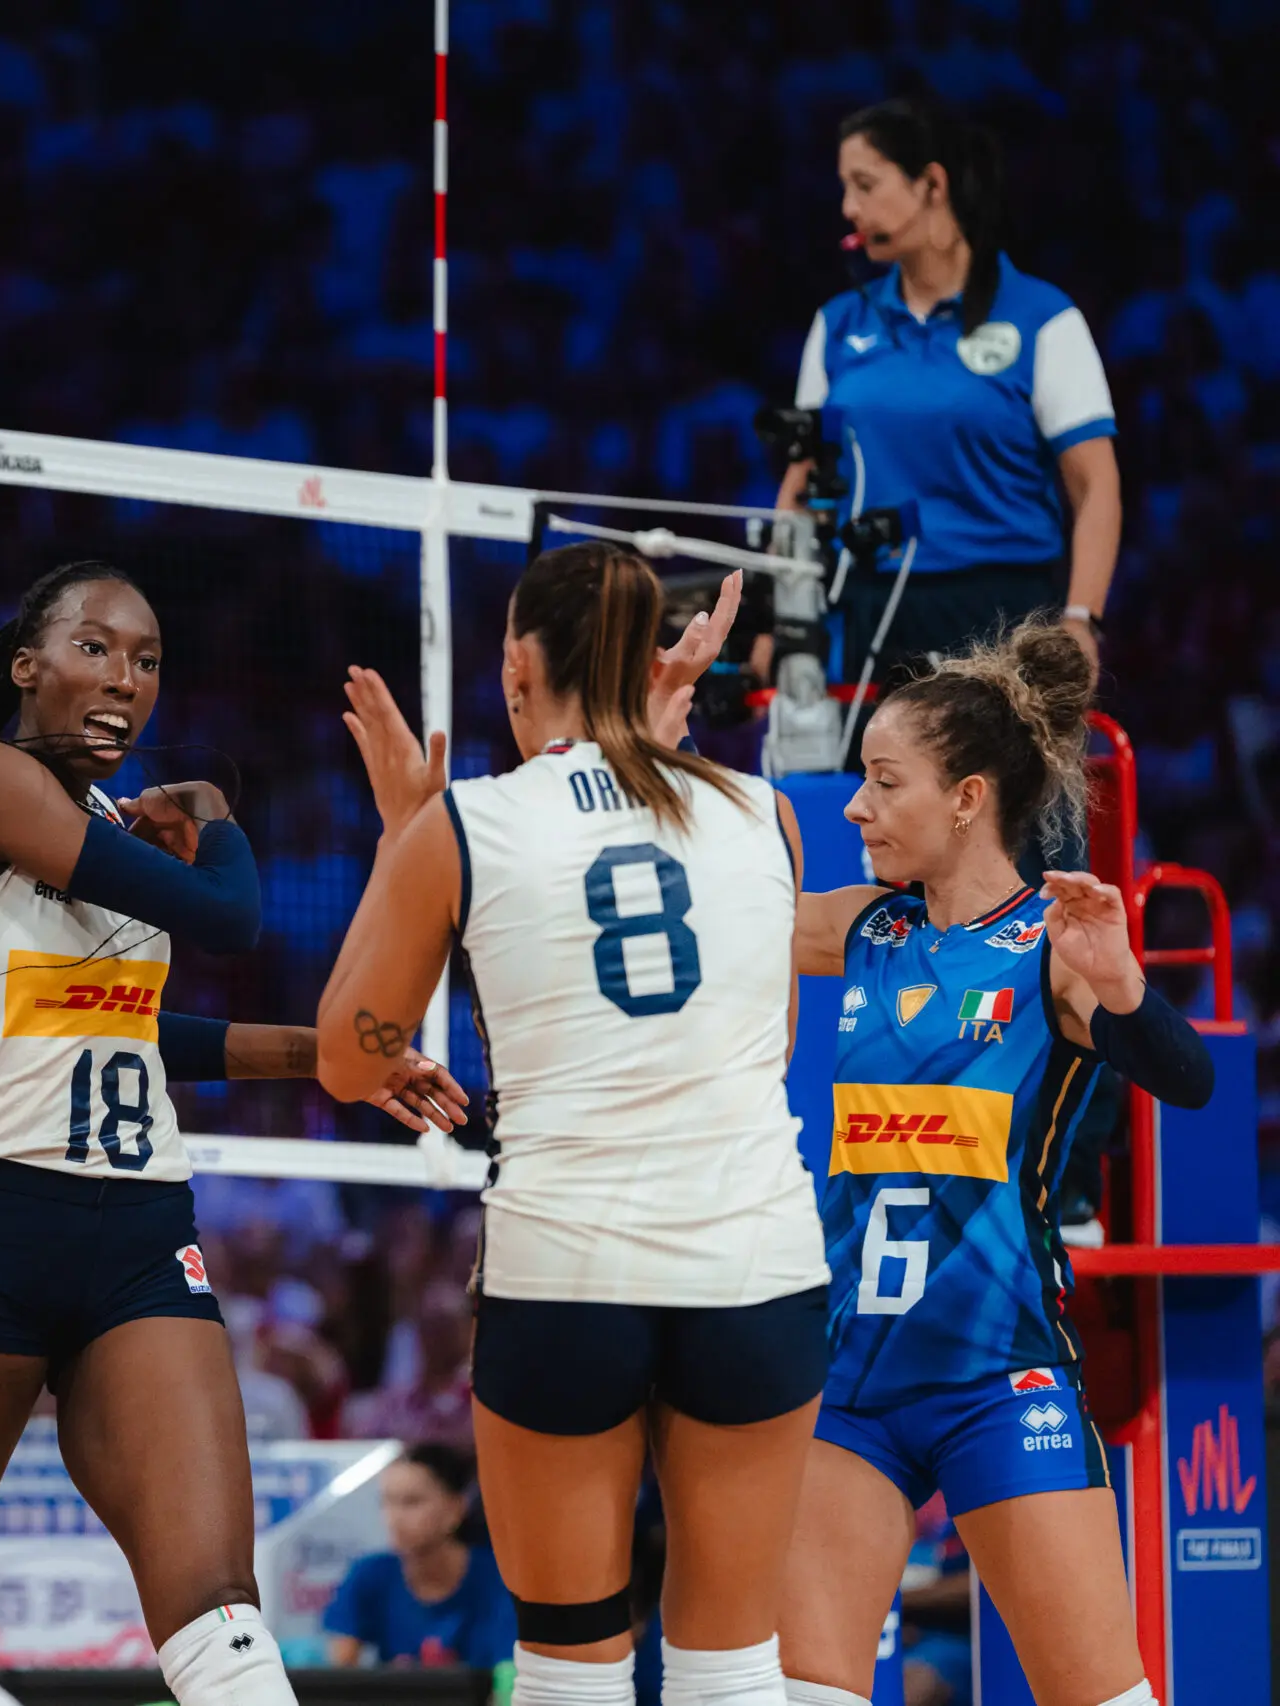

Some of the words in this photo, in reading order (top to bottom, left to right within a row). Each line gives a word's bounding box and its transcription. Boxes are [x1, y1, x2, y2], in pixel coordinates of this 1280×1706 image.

[584, 843, 702, 1017] 8
[58, 984, 157, 1017] DHL
[958, 1021, 1004, 1045] ITA
[65, 1048, 155, 1172] 18
[843, 1113, 957, 1145] DHL
[857, 1187, 930, 1315] 6
[1023, 1433, 1073, 1452] errea
[1177, 1403, 1258, 1517] VNL
